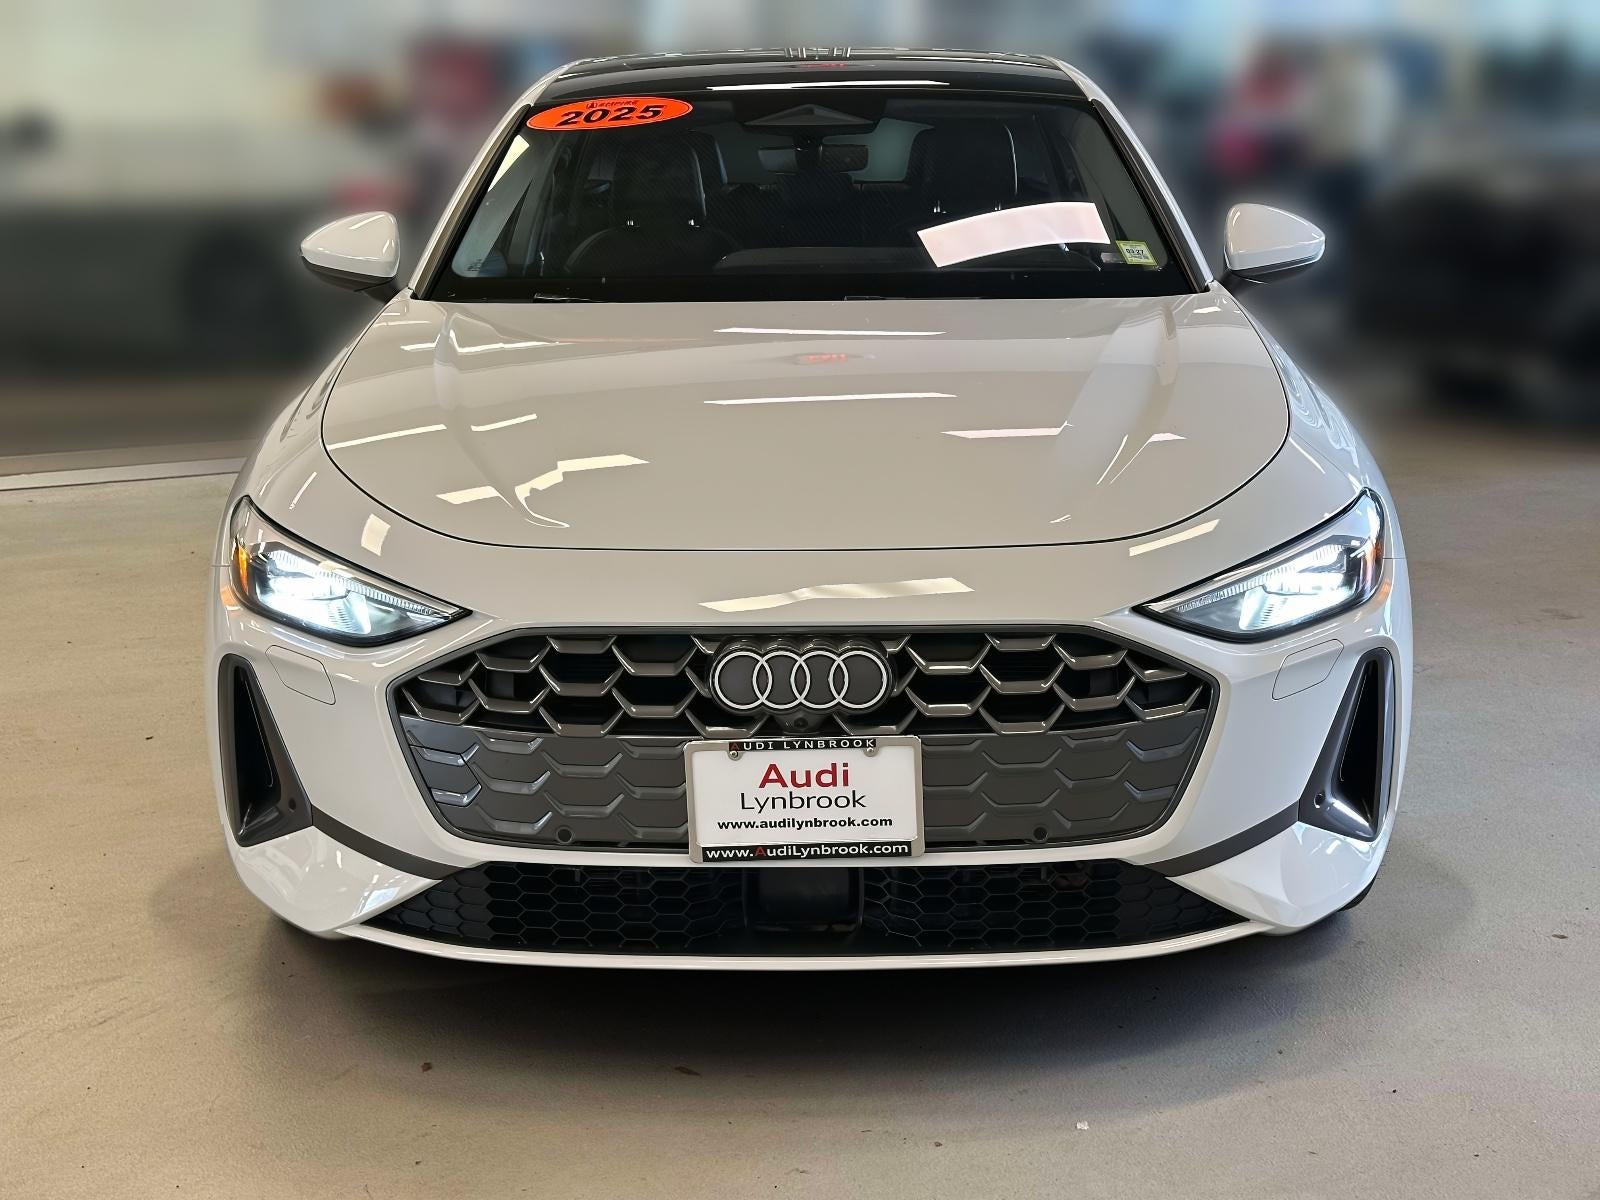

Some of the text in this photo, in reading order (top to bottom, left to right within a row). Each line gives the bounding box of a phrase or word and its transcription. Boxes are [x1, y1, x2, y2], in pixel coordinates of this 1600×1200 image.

[556, 105, 667, 127] 2025
[730, 739, 875, 751] AUDI LYNBROOK
[758, 763, 849, 788] Audi
[740, 790, 867, 814] Lynbrook
[717, 817, 893, 830] www.audilynbrook.com
[706, 843, 909, 859] www.AudiLynbrook.com
